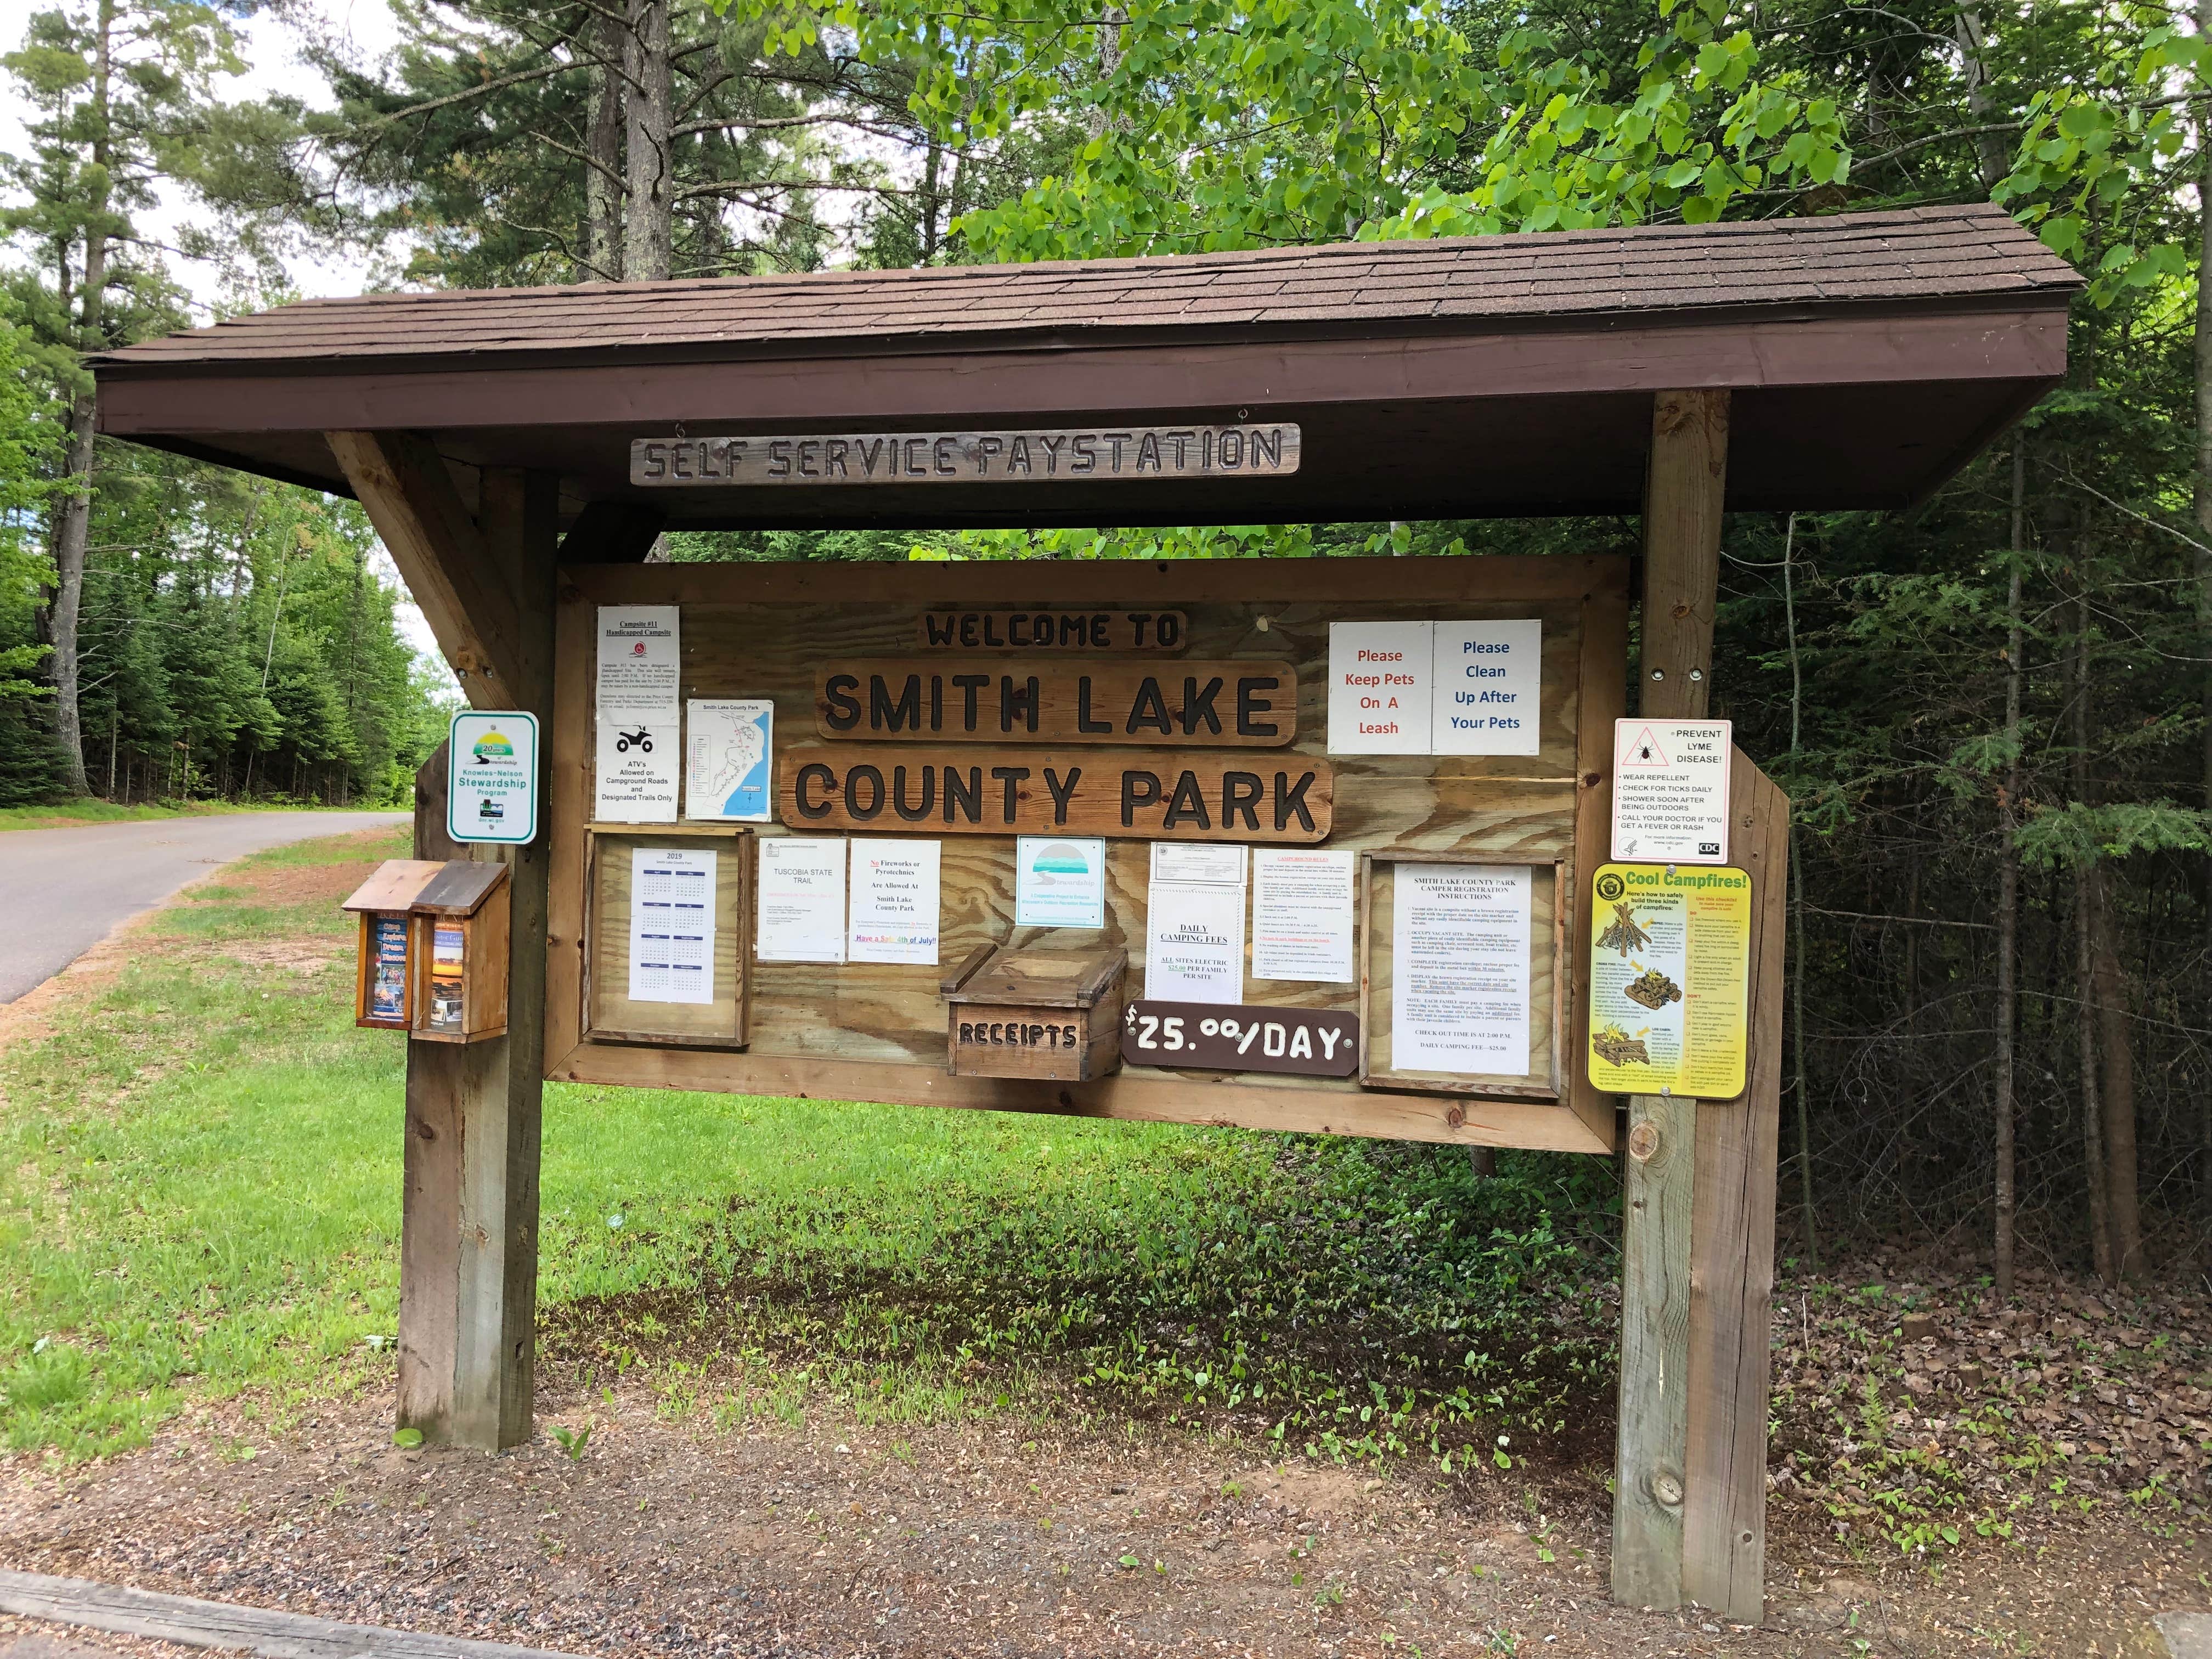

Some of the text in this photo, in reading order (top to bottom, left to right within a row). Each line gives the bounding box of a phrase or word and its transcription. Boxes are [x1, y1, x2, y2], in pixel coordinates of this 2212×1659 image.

[644, 430, 1281, 479] SELF SERVICE PAYSTATION
[926, 614, 1179, 647] WELCOME TO
[1464, 642, 1509, 653] Please
[1358, 650, 1402, 661] Please
[1466, 666, 1505, 677] Clean
[1346, 674, 1414, 687] Keep Pets
[1360, 697, 1398, 708] On A
[1455, 691, 1516, 705] Up After
[825, 674, 1278, 737] SMITH LAKE
[1359, 722, 1398, 733] Leash
[1451, 717, 1520, 729] Your Pets
[459, 777, 526, 789] Stewardship
[795, 763, 1317, 832] COUNTY PARK
[1700, 844, 1719, 852] CDC
[1626, 872, 1747, 889] Cool Campfires!
[1181, 924, 1208, 933] DAILY
[918, 937, 936, 945] July!!
[1161, 934, 1228, 944] CAMPING FEES
[960, 1023, 1076, 1048] RECEIPTS
